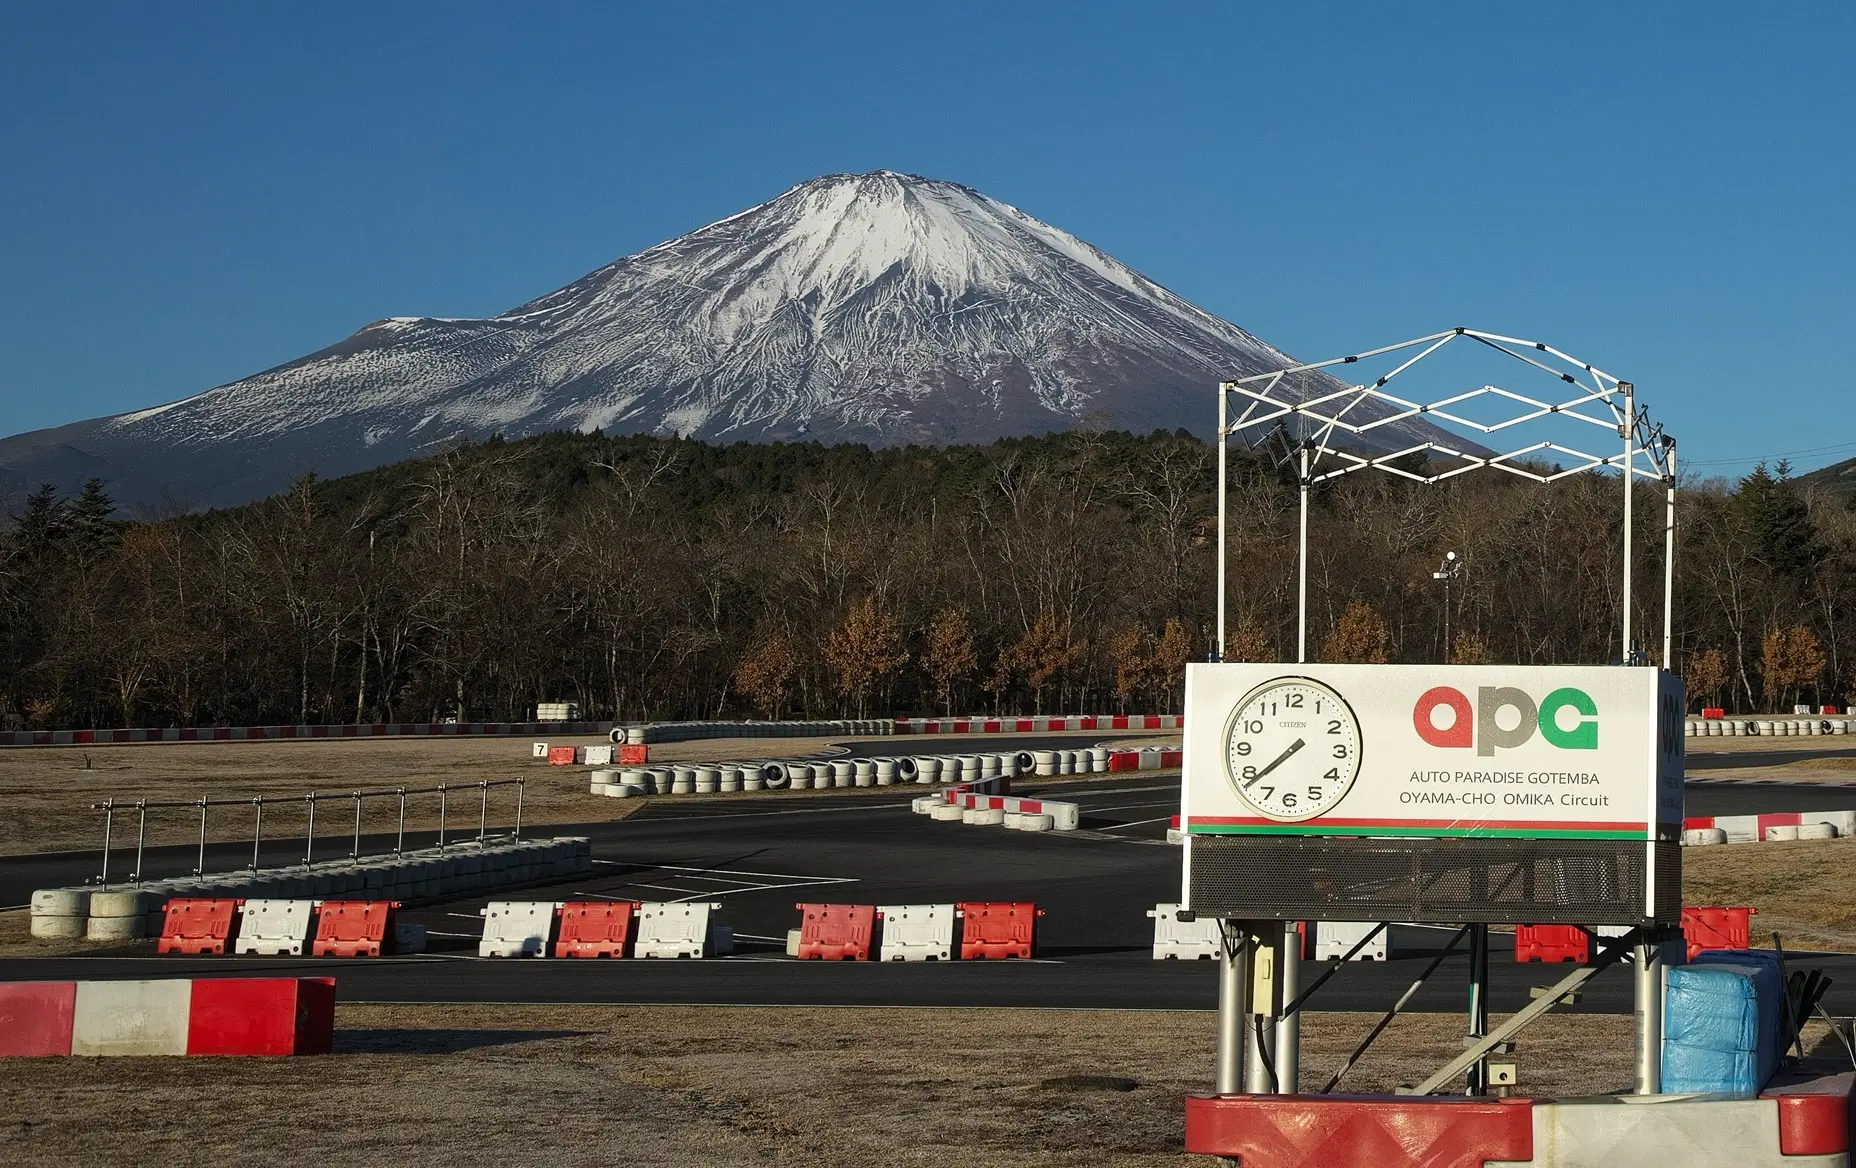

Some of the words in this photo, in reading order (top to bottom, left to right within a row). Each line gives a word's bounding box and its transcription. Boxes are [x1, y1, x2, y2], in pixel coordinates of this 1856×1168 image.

[1284, 693, 1304, 708] 12
[1315, 700, 1321, 715] 1
[1260, 702, 1277, 716] 11
[1243, 719, 1263, 734] 10
[1327, 720, 1341, 734] 2
[1237, 742, 1252, 756] 9
[1333, 744, 1347, 759] 3
[1242, 766, 1257, 780] 8
[1324, 767, 1340, 781] 4
[1409, 770, 1450, 783] AUTO
[1454, 771, 1524, 784] PARADISE
[1527, 772, 1600, 785] GOTEMBA
[1260, 786, 1275, 801] 7
[1282, 793, 1297, 807] 6
[1307, 786, 1322, 801] 5
[1399, 791, 1496, 805] OYAMA-CHO
[1503, 792, 1555, 806] OMIKA
[1560, 793, 1609, 806] Circuit
